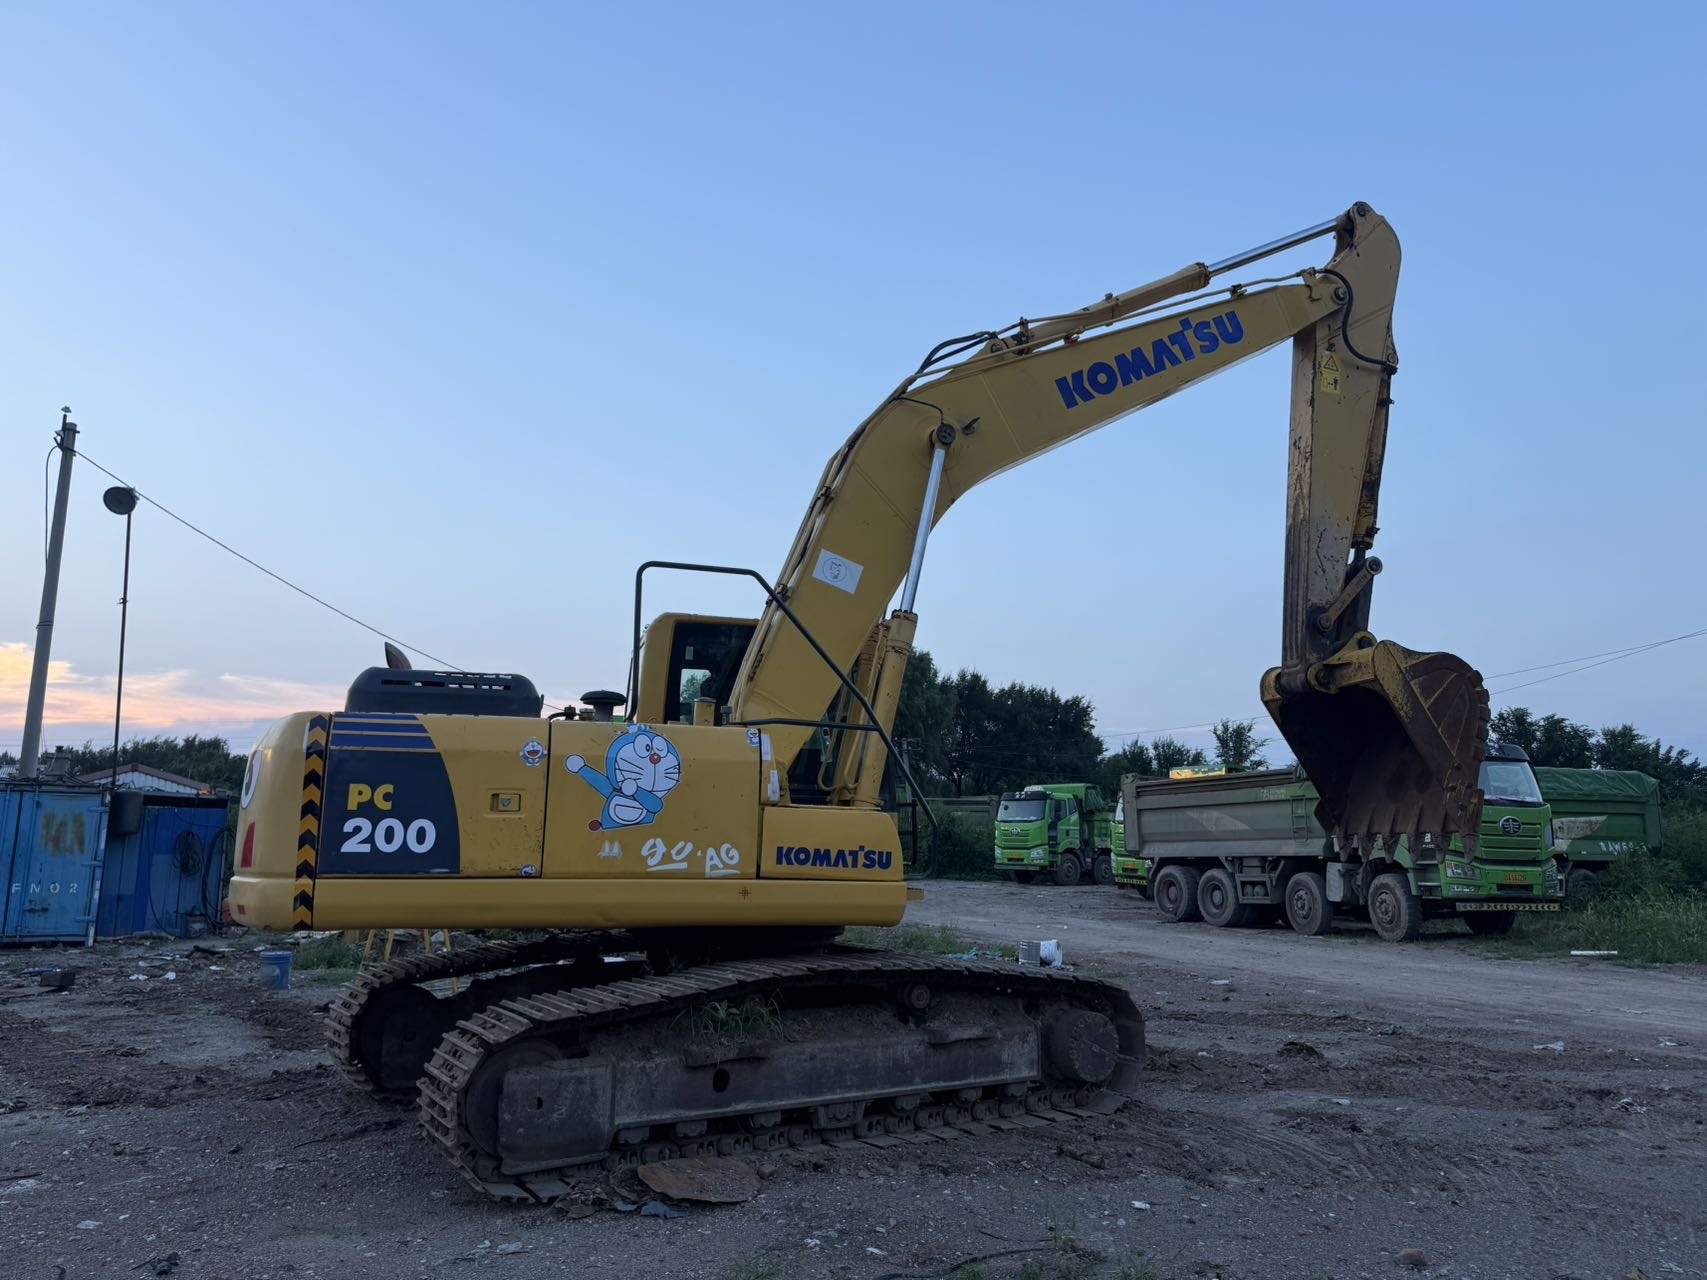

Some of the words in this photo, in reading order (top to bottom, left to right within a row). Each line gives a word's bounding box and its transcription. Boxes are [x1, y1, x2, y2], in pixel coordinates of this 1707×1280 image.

[1055, 310, 1244, 410] KOMATSU
[347, 783, 394, 811] PC
[340, 817, 436, 854] 200
[776, 845, 892, 869] KOMATSU
